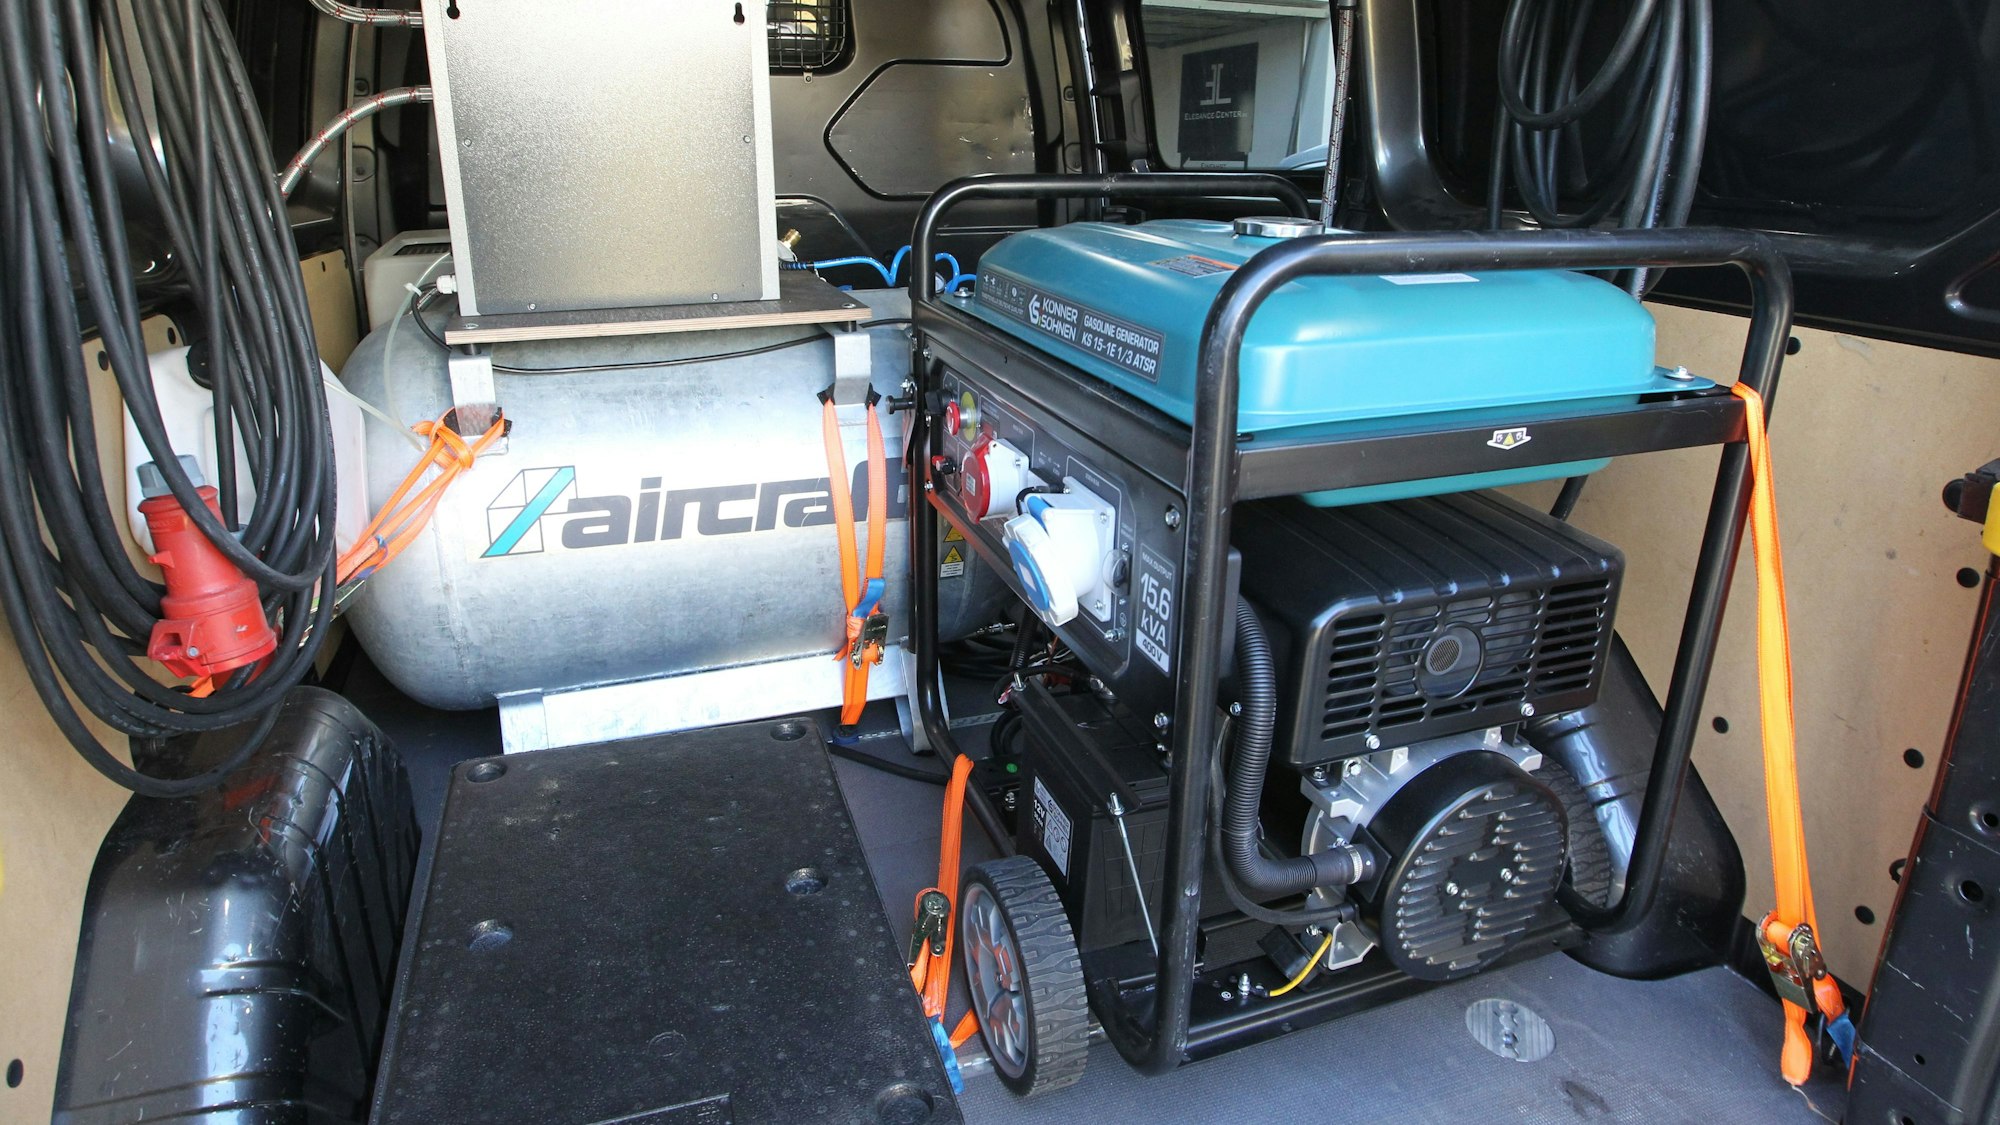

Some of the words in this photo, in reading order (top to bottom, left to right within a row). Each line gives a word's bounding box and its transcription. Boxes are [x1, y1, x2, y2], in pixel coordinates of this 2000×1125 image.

[1040, 314, 1077, 342] SOHNEN
[1042, 297, 1079, 324] KONNER
[1081, 331, 1092, 347] KS
[1093, 336, 1117, 358] 15-1E
[1117, 346, 1133, 364] 1/3
[1132, 353, 1157, 375] ATSR
[1083, 314, 1116, 337] GASOLINE
[1116, 327, 1160, 355] GENERATOR
[1140, 572, 1171, 621] 15.6
[1140, 609, 1166, 648] kVA
[1033, 799, 1047, 819] 12V
